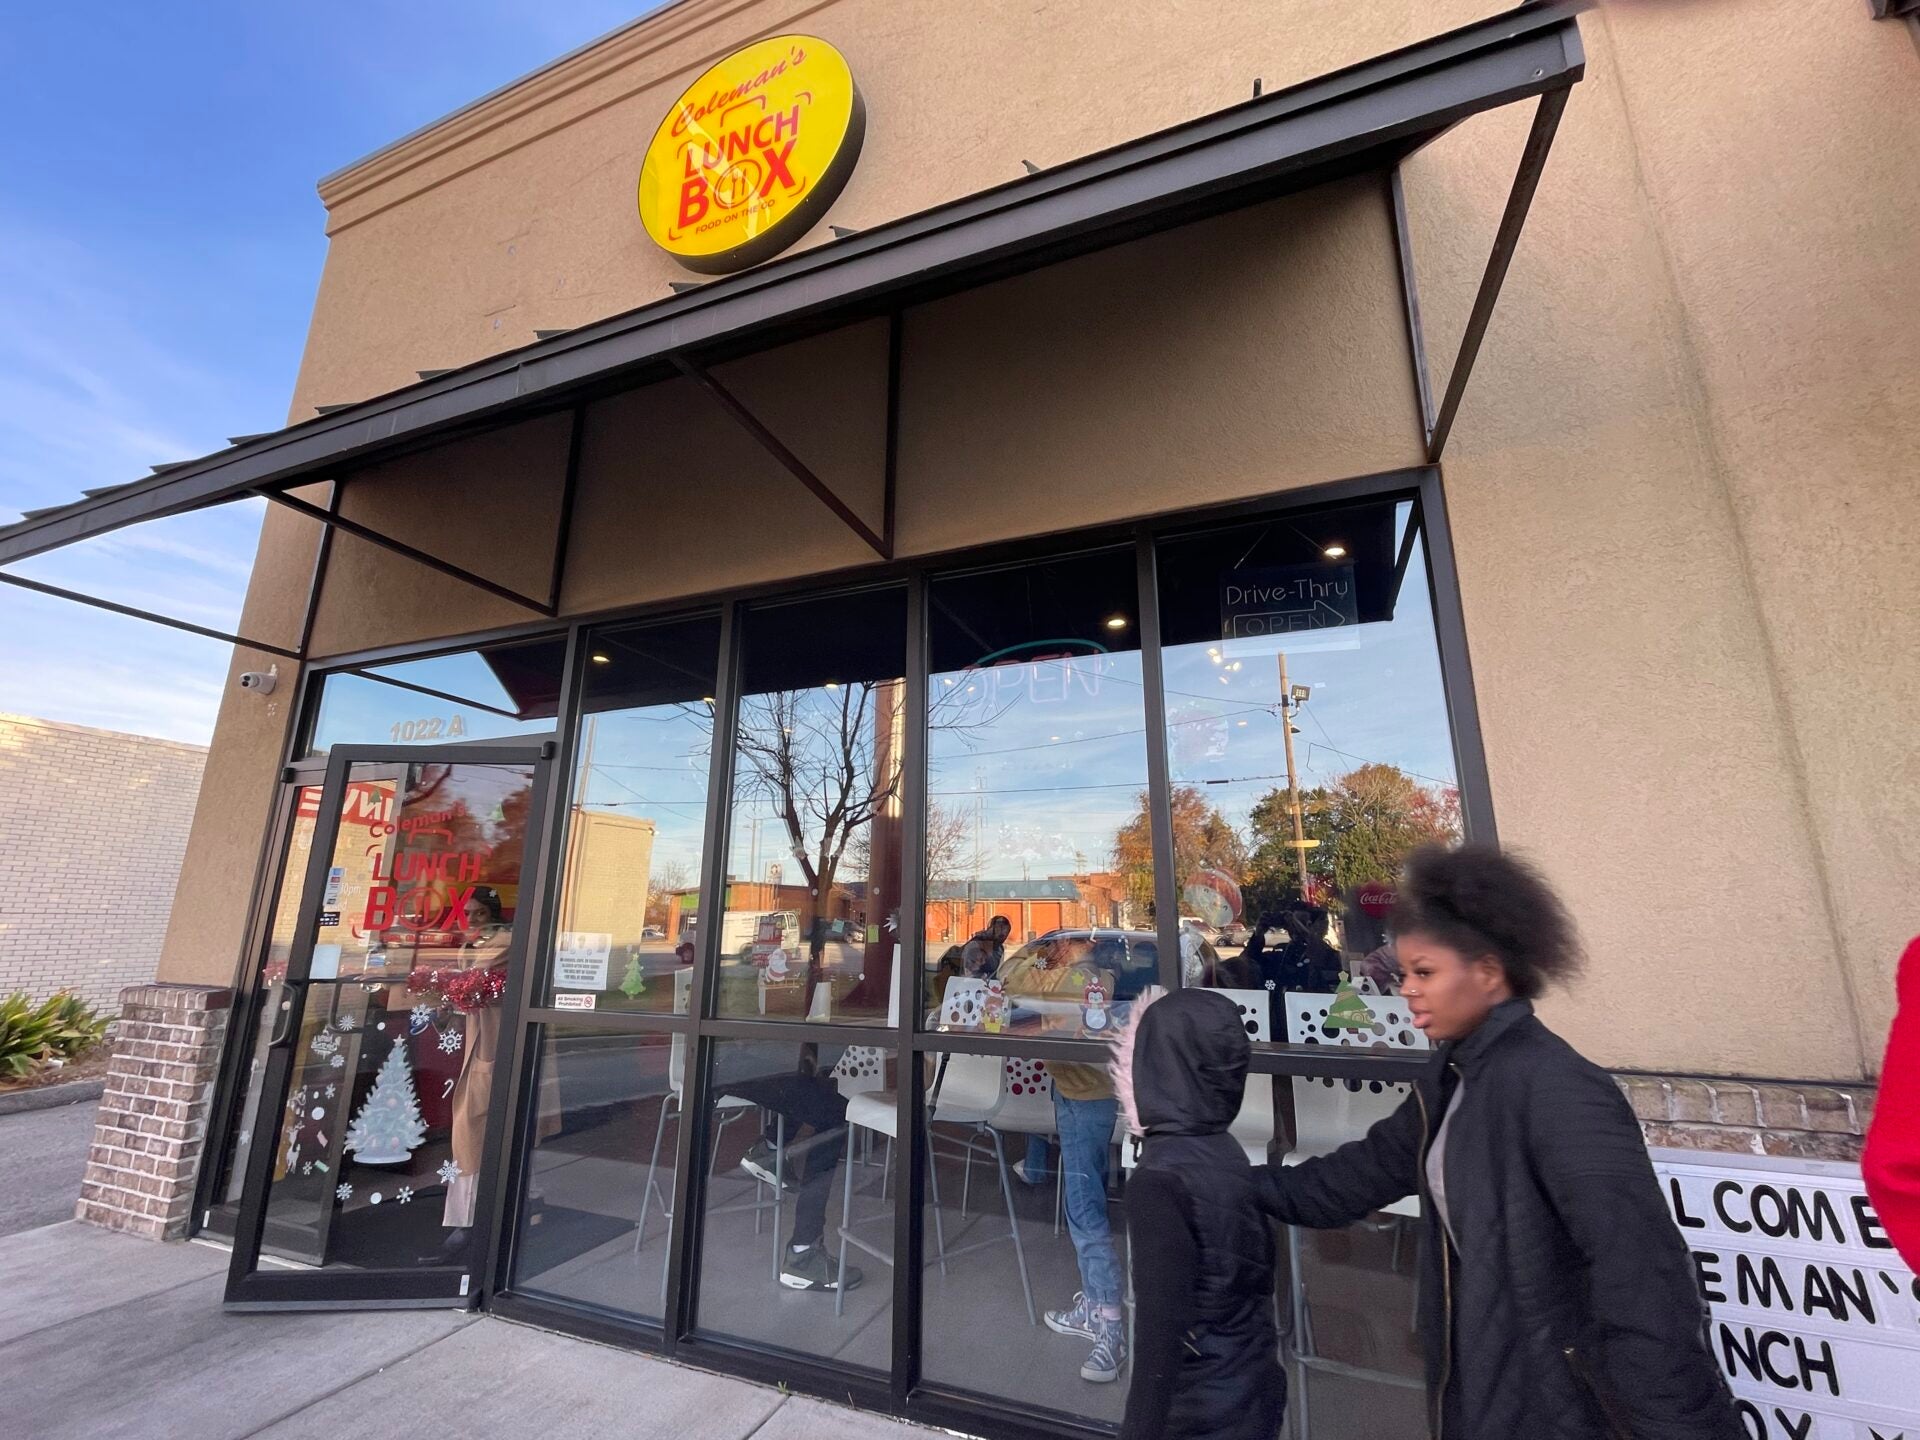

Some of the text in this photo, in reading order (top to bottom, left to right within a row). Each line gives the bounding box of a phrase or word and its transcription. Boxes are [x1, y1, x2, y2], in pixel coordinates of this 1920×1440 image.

[671, 46, 807, 137] Coleman's
[683, 104, 799, 179] LUNCH
[677, 138, 797, 230] BOX
[695, 219, 721, 235] FOOD
[724, 212, 738, 224] ON
[741, 204, 758, 217] THE
[1226, 578, 1349, 605] Drive-Thru
[1246, 612, 1326, 635] OPEN
[953, 650, 1100, 711] OPEN
[391, 714, 465, 742] 1022 A
[369, 798, 466, 838] Coleman's
[371, 852, 481, 882] LUNCH
[363, 885, 476, 931] BOX
[1360, 891, 1398, 904] Coca-Col
